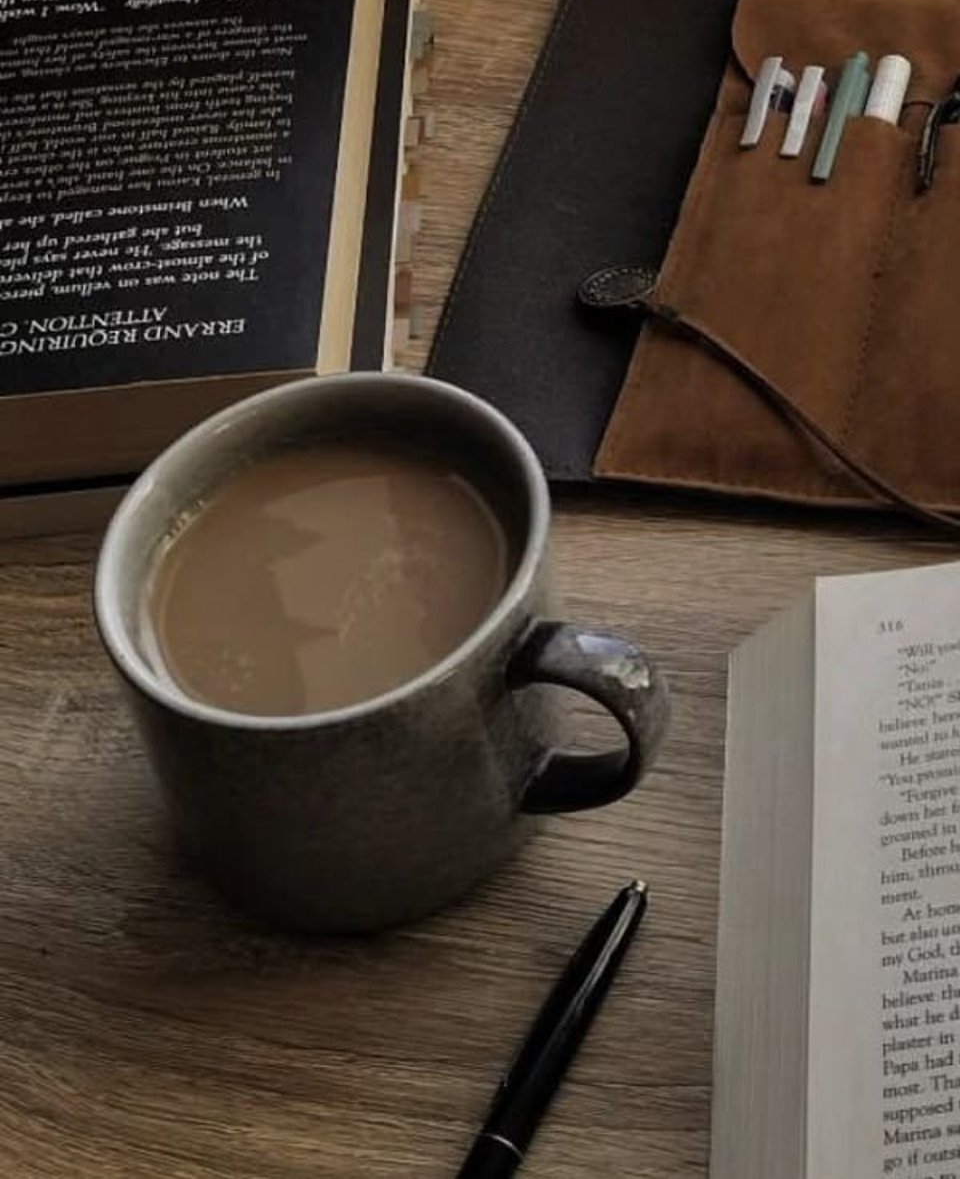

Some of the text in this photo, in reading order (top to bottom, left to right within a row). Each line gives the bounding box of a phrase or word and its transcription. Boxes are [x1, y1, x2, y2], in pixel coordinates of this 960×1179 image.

[107, 202, 193, 215] Brimstone
[199, 198, 248, 209] When
[18, 216, 45, 228] she
[3, 225, 203, 256] but she gathered up her
[236, 236, 263, 248] the
[33, 246, 69, 264] says
[73, 249, 119, 260] never
[70, 252, 270, 279] of the almost-crow that
[118, 269, 259, 288] The note was on
[0, 320, 245, 355] ERRAND REQUIRING
[882, 991, 935, 1008] believe
[883, 1157, 903, 1171] go
[907, 1148, 919, 1164] if
